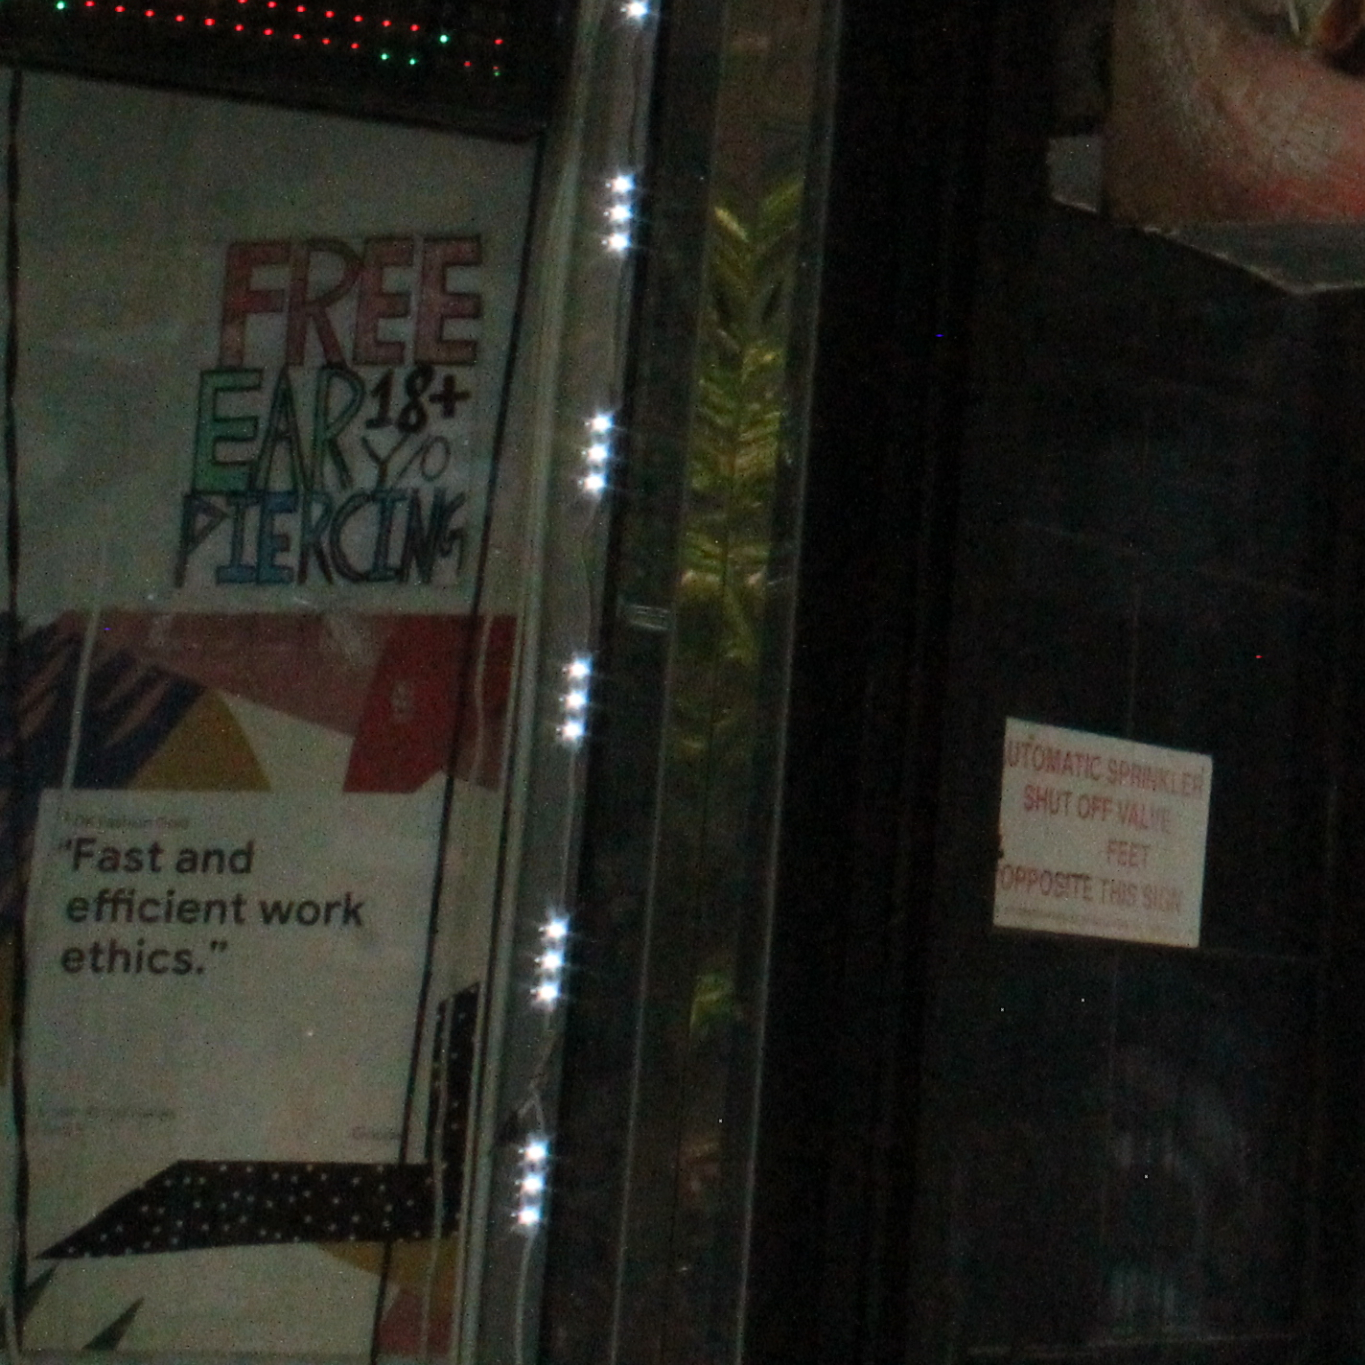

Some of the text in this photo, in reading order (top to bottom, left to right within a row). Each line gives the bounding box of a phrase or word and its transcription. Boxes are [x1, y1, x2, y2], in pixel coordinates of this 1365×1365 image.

[218, 235, 482, 367] FREE
[192, 365, 472, 492] EAR 18+
[175, 489, 467, 588] PIERCING
[1023, 784, 1073, 816] SHUT
[1077, 792, 1113, 822] OFF
[175, 839, 255, 874] and
[1107, 840, 1150, 867] FEET
[1000, 863, 1092, 902] OPPOSITE
[66, 889, 365, 926] efficient work
